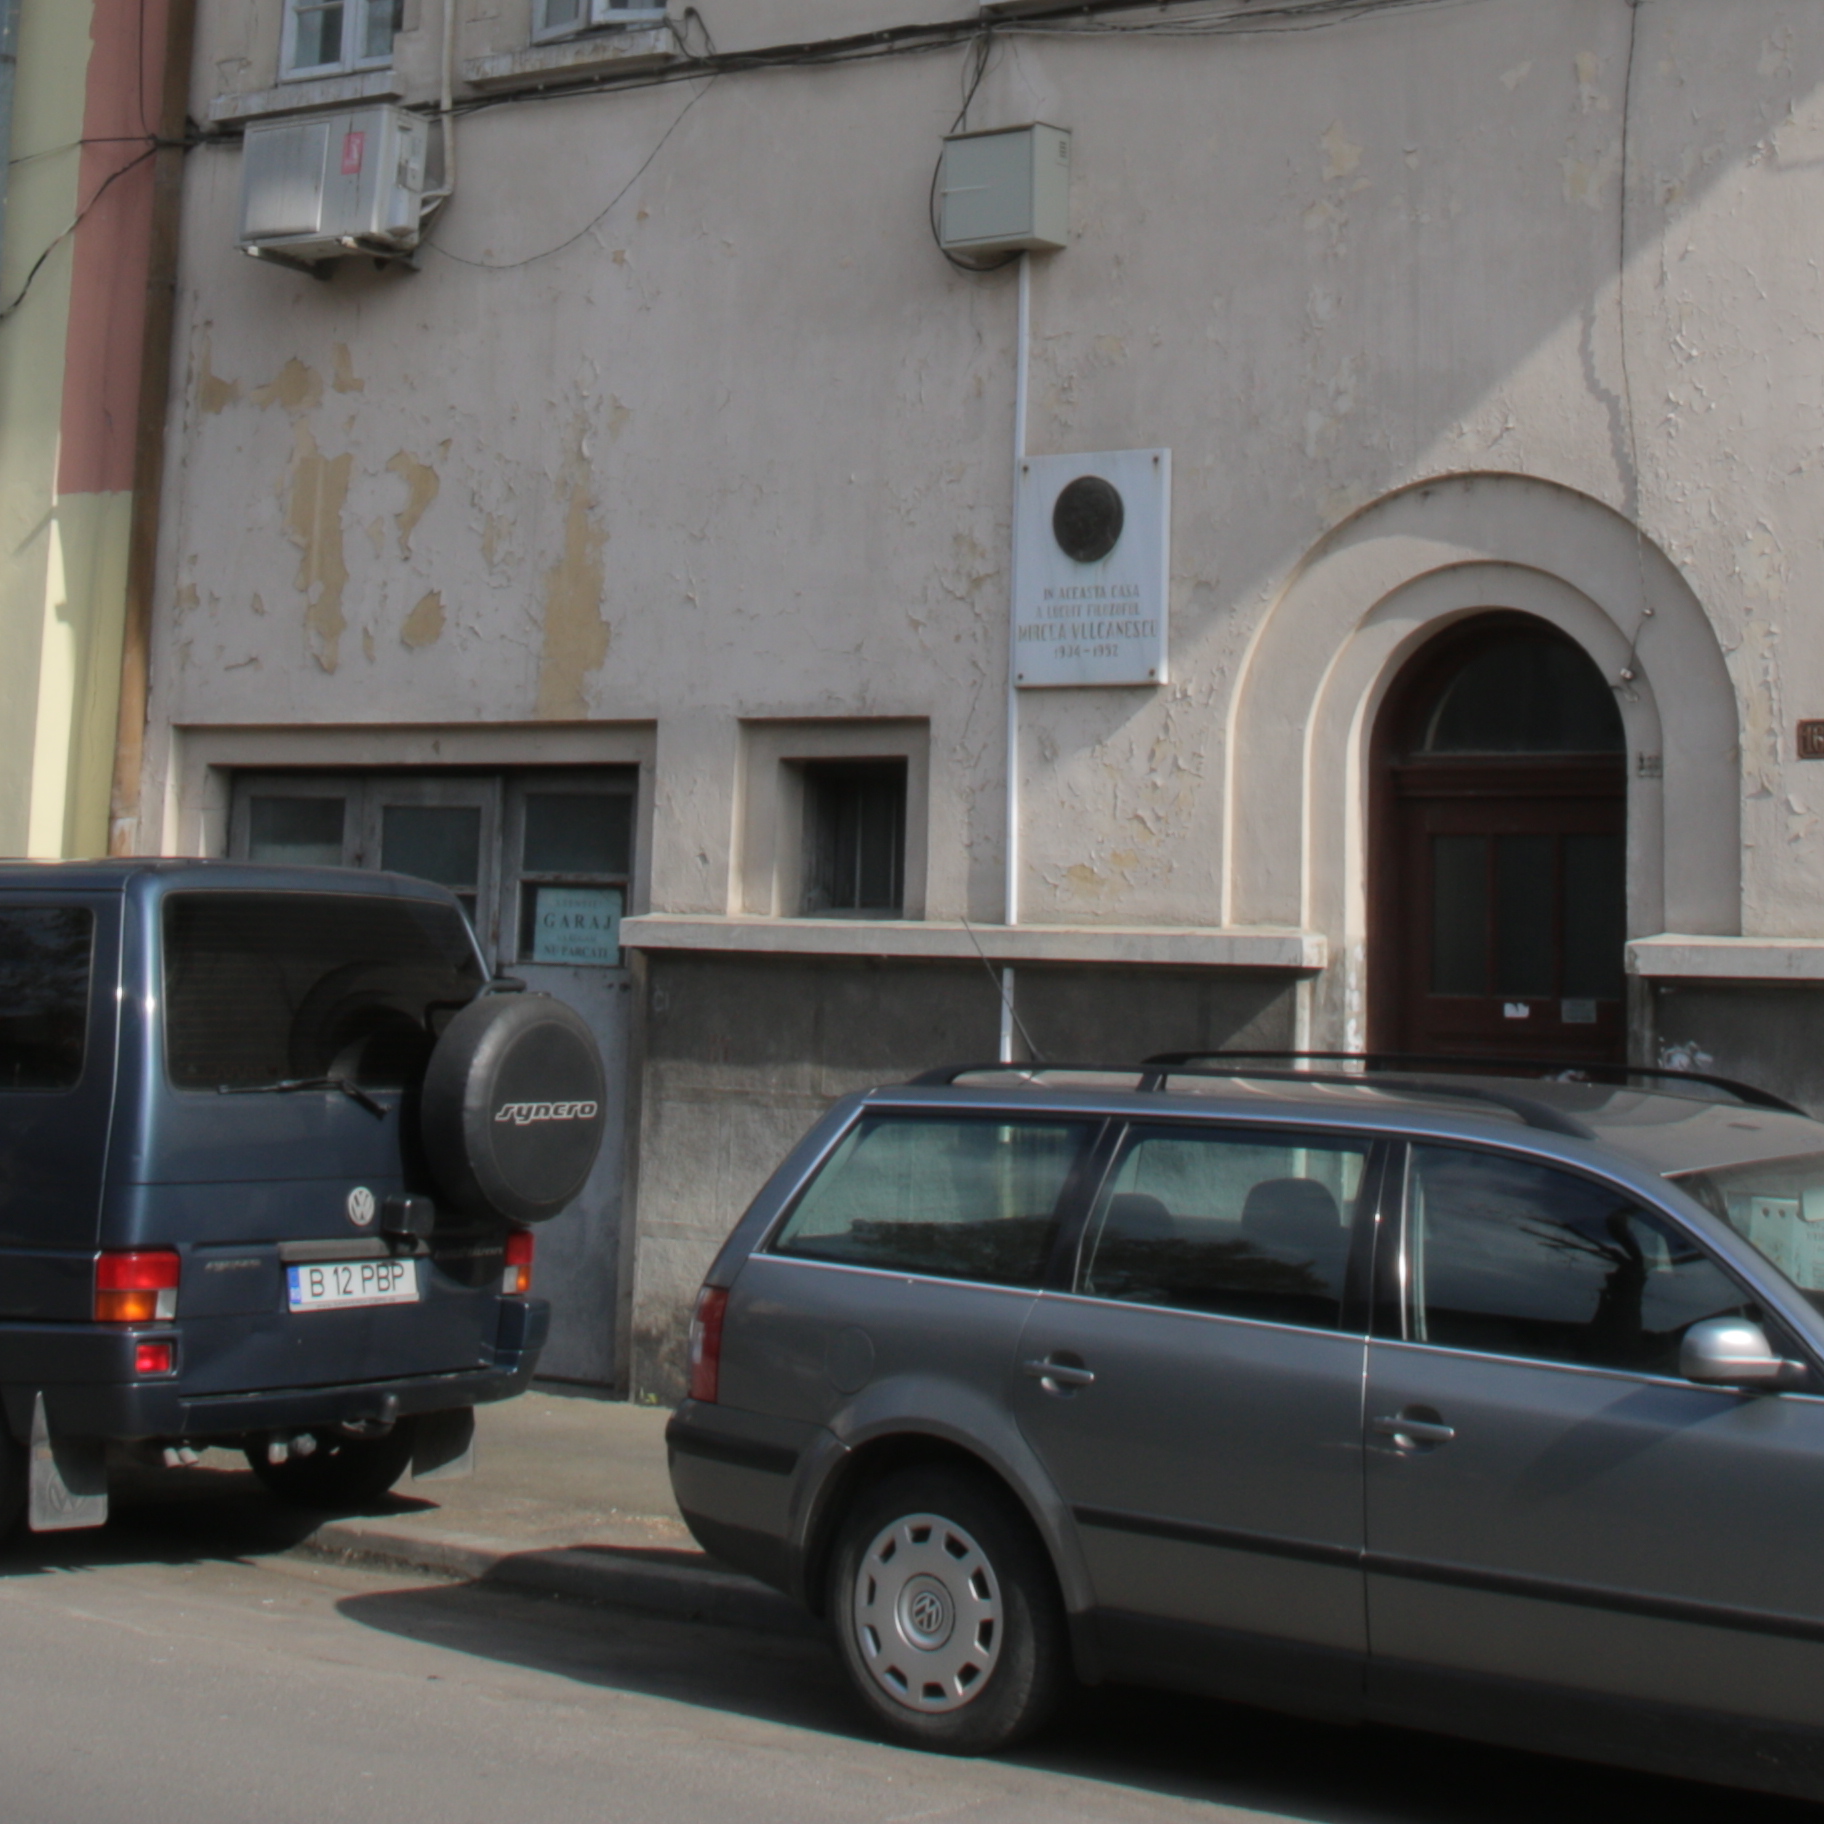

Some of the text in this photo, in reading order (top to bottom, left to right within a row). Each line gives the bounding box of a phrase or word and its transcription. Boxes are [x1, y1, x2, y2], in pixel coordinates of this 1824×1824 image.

[1043, 584, 1140, 600] IN ACEASTA CASA
[1036, 605, 1043, 618] A
[1046, 603, 1082, 618] LOCUIT
[1018, 619, 1158, 642] MIRCEA VULCANESCU
[543, 912, 612, 930] GARAJ
[495, 1101, 598, 1126] syncro
[309, 1261, 405, 1298] B 12 PBP
